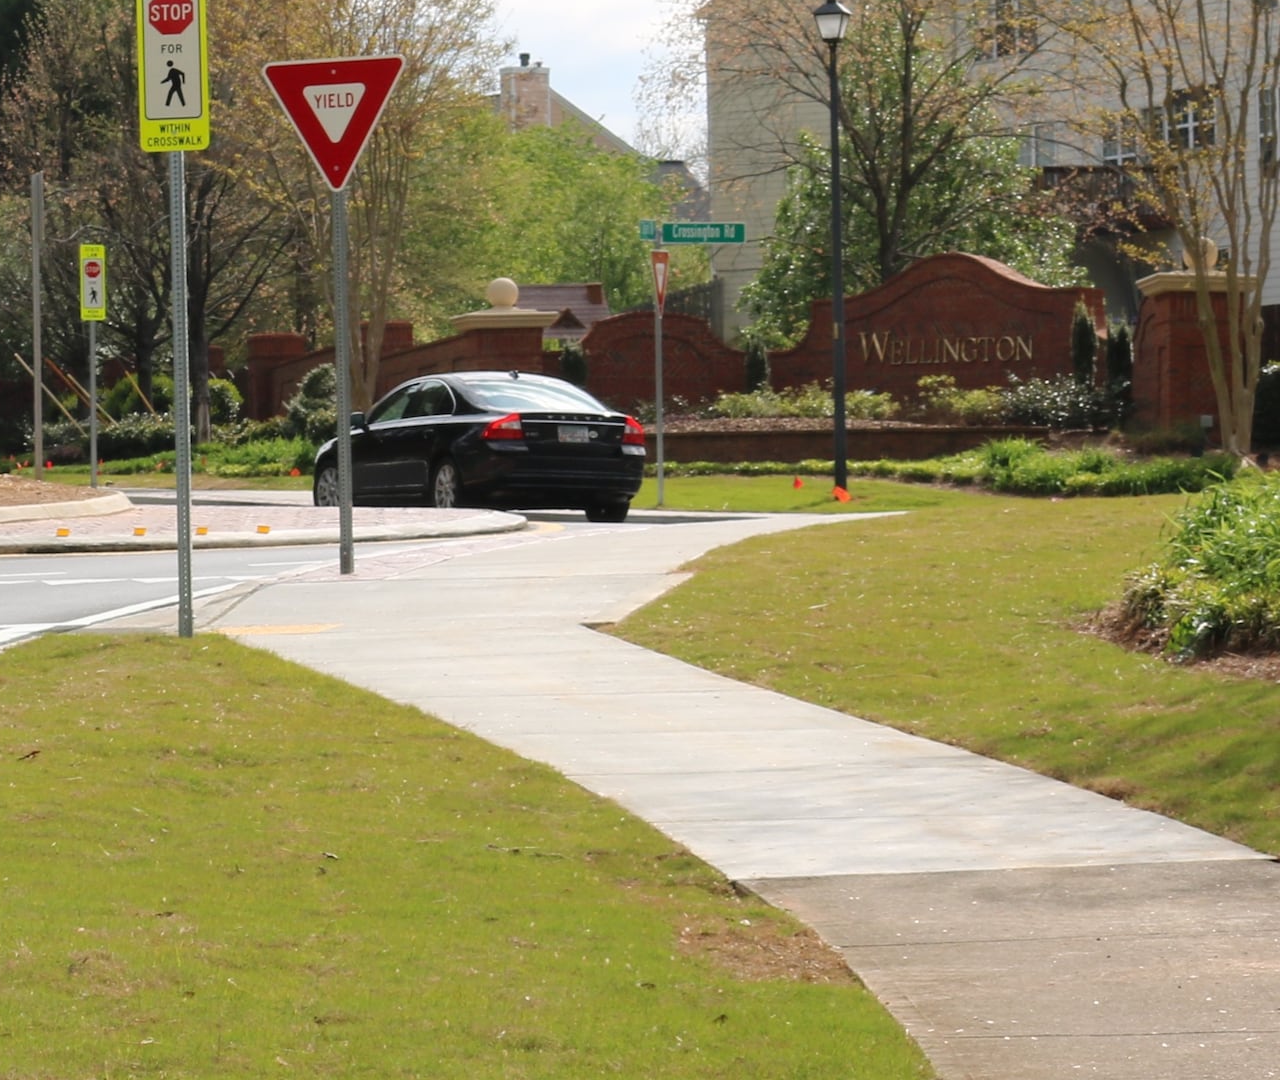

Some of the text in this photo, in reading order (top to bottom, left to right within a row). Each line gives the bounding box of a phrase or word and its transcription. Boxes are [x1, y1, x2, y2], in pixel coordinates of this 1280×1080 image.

[150, 2, 192, 22] STOP
[160, 43, 183, 54] FOR
[313, 92, 355, 109] YIELD
[159, 122, 191, 133] WITHIN
[146, 135, 203, 148] CROSSWALK
[724, 224, 735, 238] Rd
[858, 330, 1033, 365] WELLINGTON
